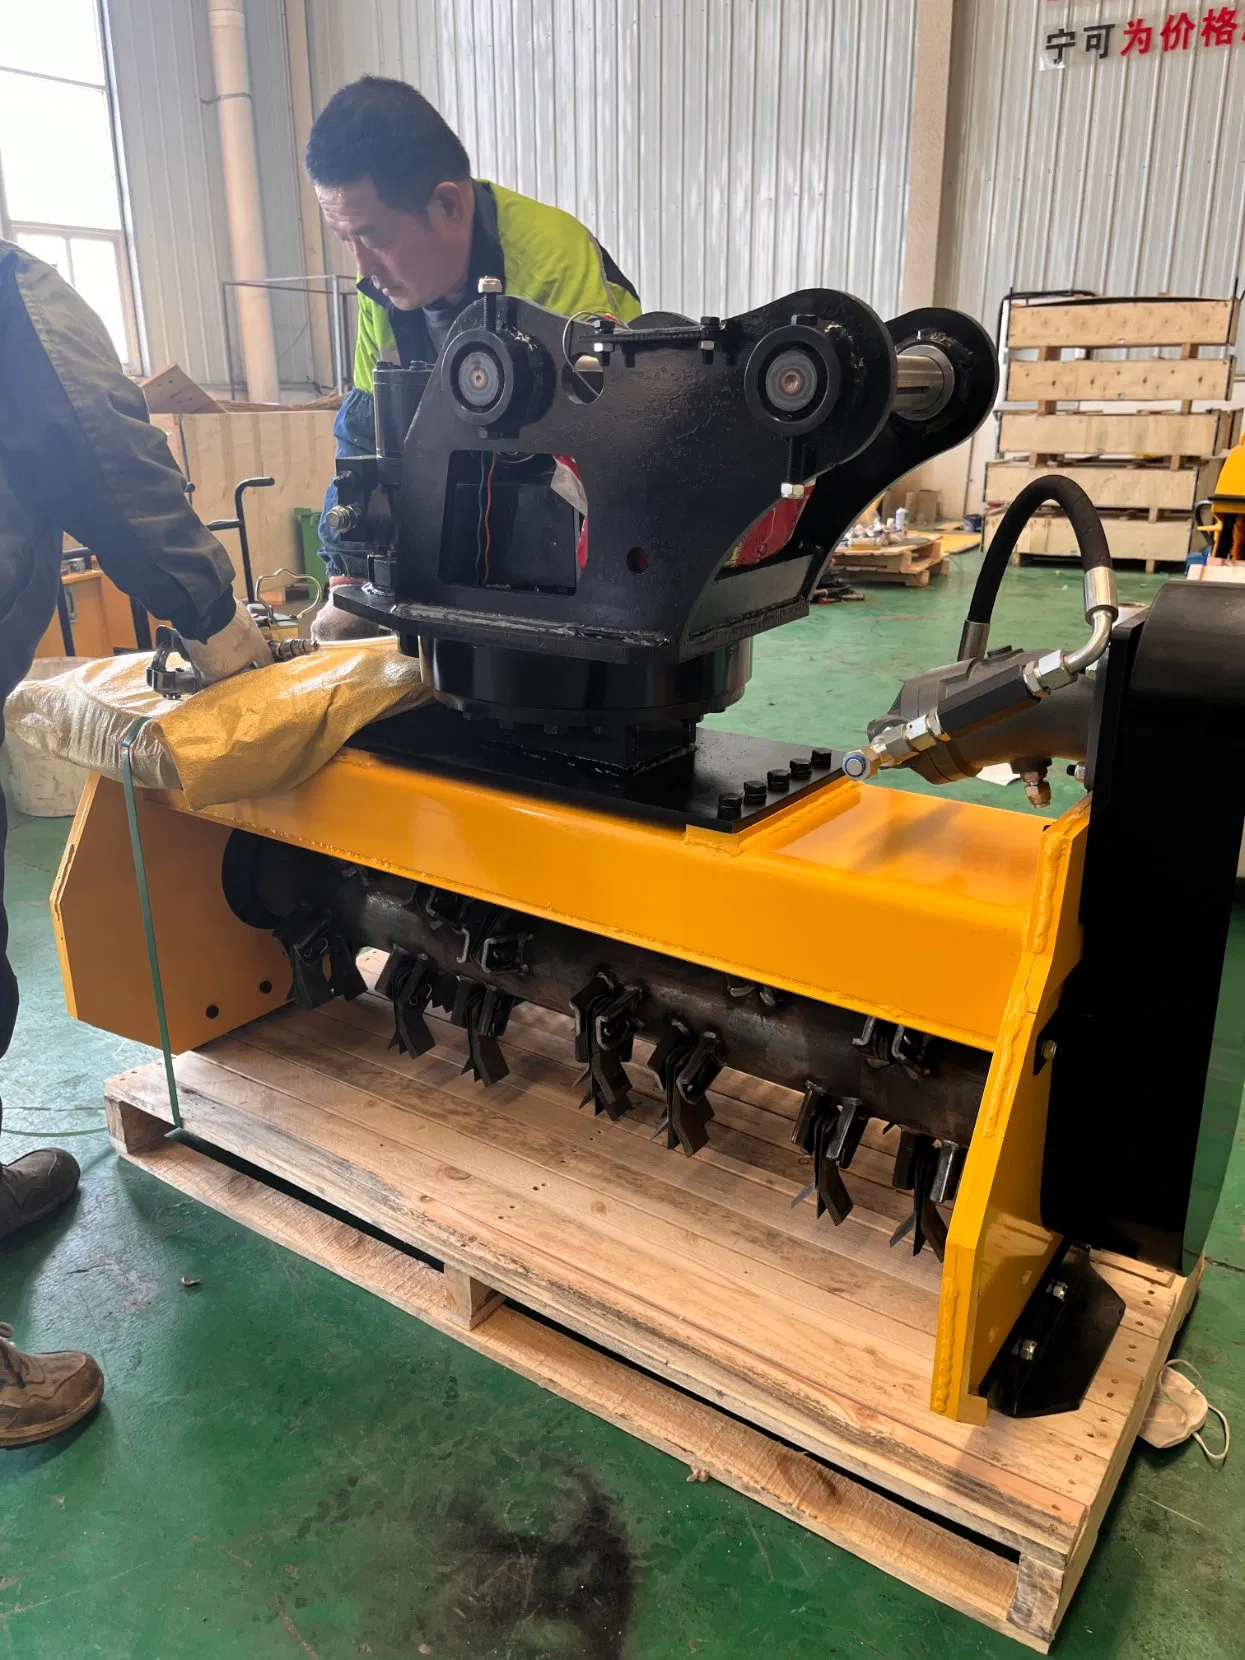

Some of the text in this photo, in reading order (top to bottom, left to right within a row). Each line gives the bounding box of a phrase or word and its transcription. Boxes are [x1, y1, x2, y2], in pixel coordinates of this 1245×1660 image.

[1046, 6, 1245, 65] 宁可为价格
